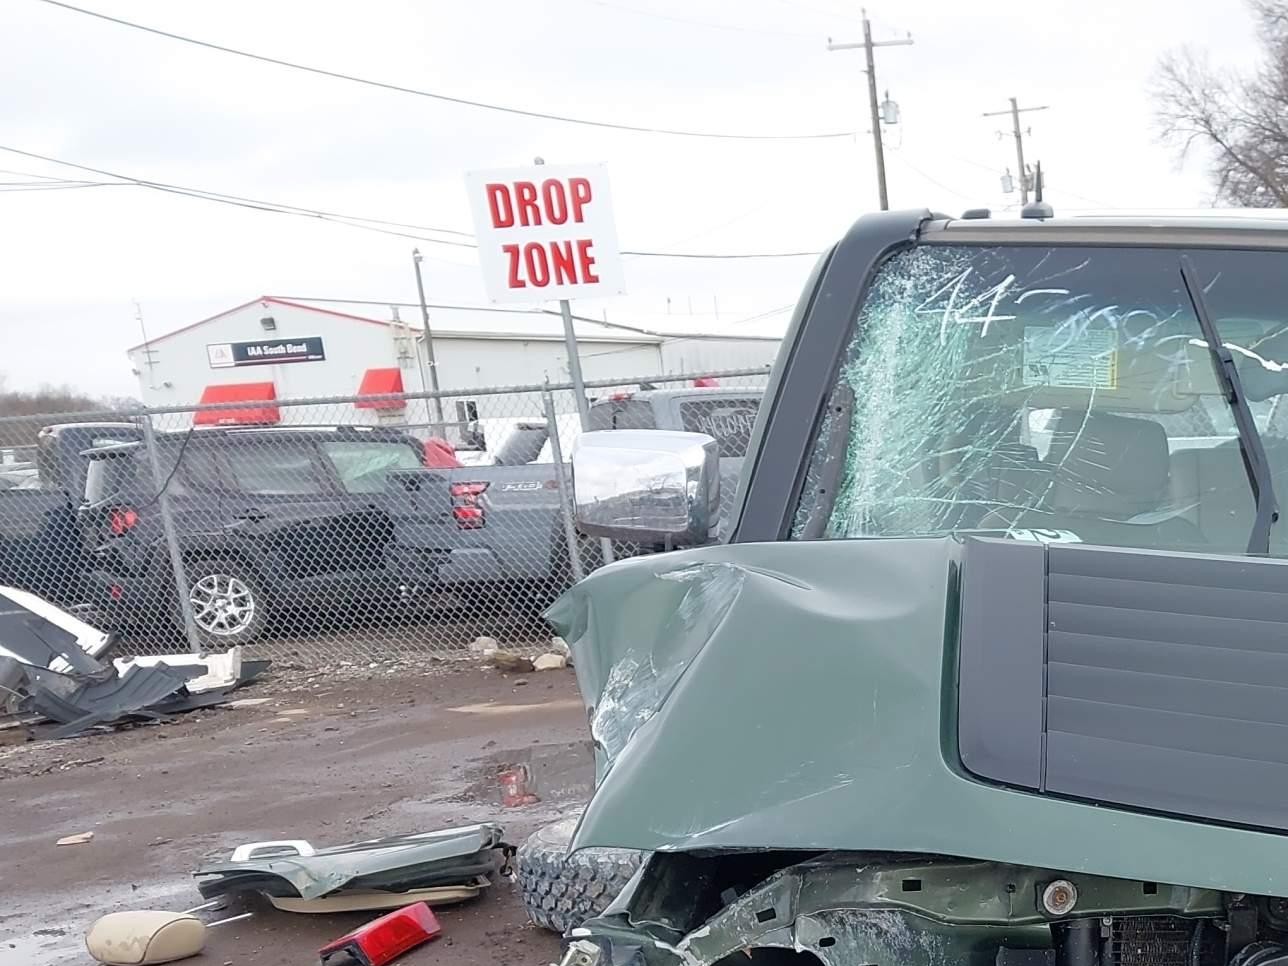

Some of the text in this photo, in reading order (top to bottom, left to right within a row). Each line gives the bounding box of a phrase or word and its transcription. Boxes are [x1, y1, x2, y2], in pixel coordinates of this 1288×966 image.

[485, 177, 592, 229] DROP
[501, 238, 600, 289] ZONE
[247, 342, 307, 356] IAA South Bend
